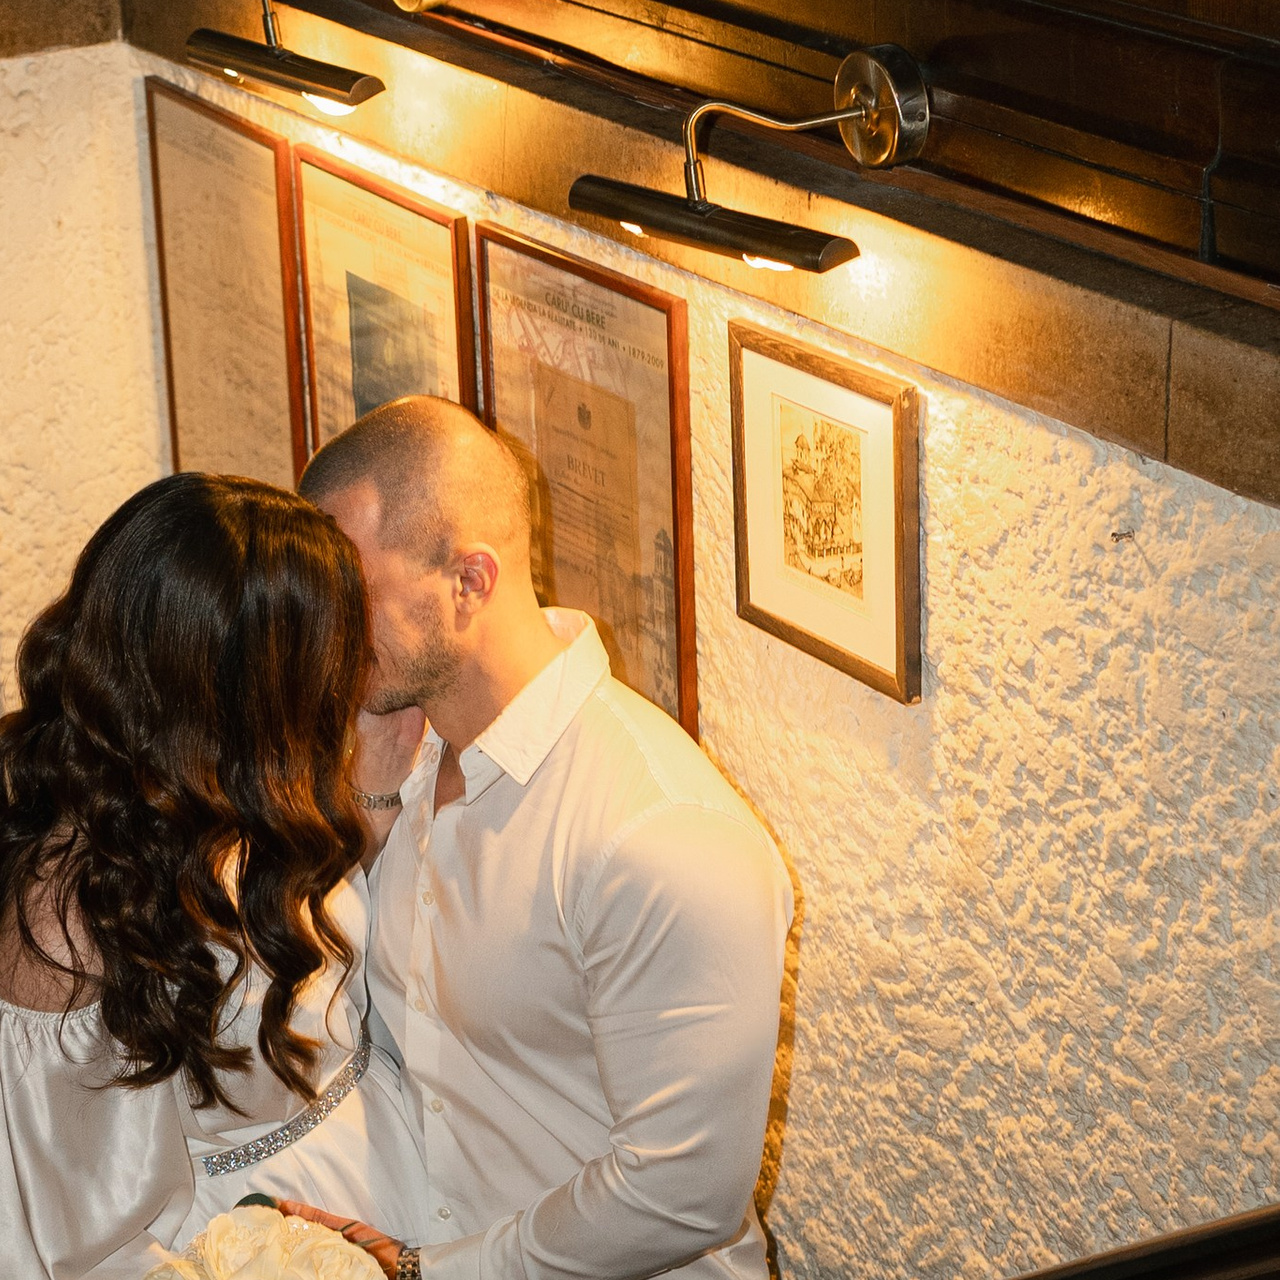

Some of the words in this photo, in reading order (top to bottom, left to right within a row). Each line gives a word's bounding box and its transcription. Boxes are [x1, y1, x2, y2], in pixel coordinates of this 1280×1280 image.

[545, 292, 568, 313] CARU'
[571, 303, 583, 319] CU
[586, 308, 606, 330] BERE
[607, 336, 619, 350] ANI
[567, 455, 606, 487] BREVET
